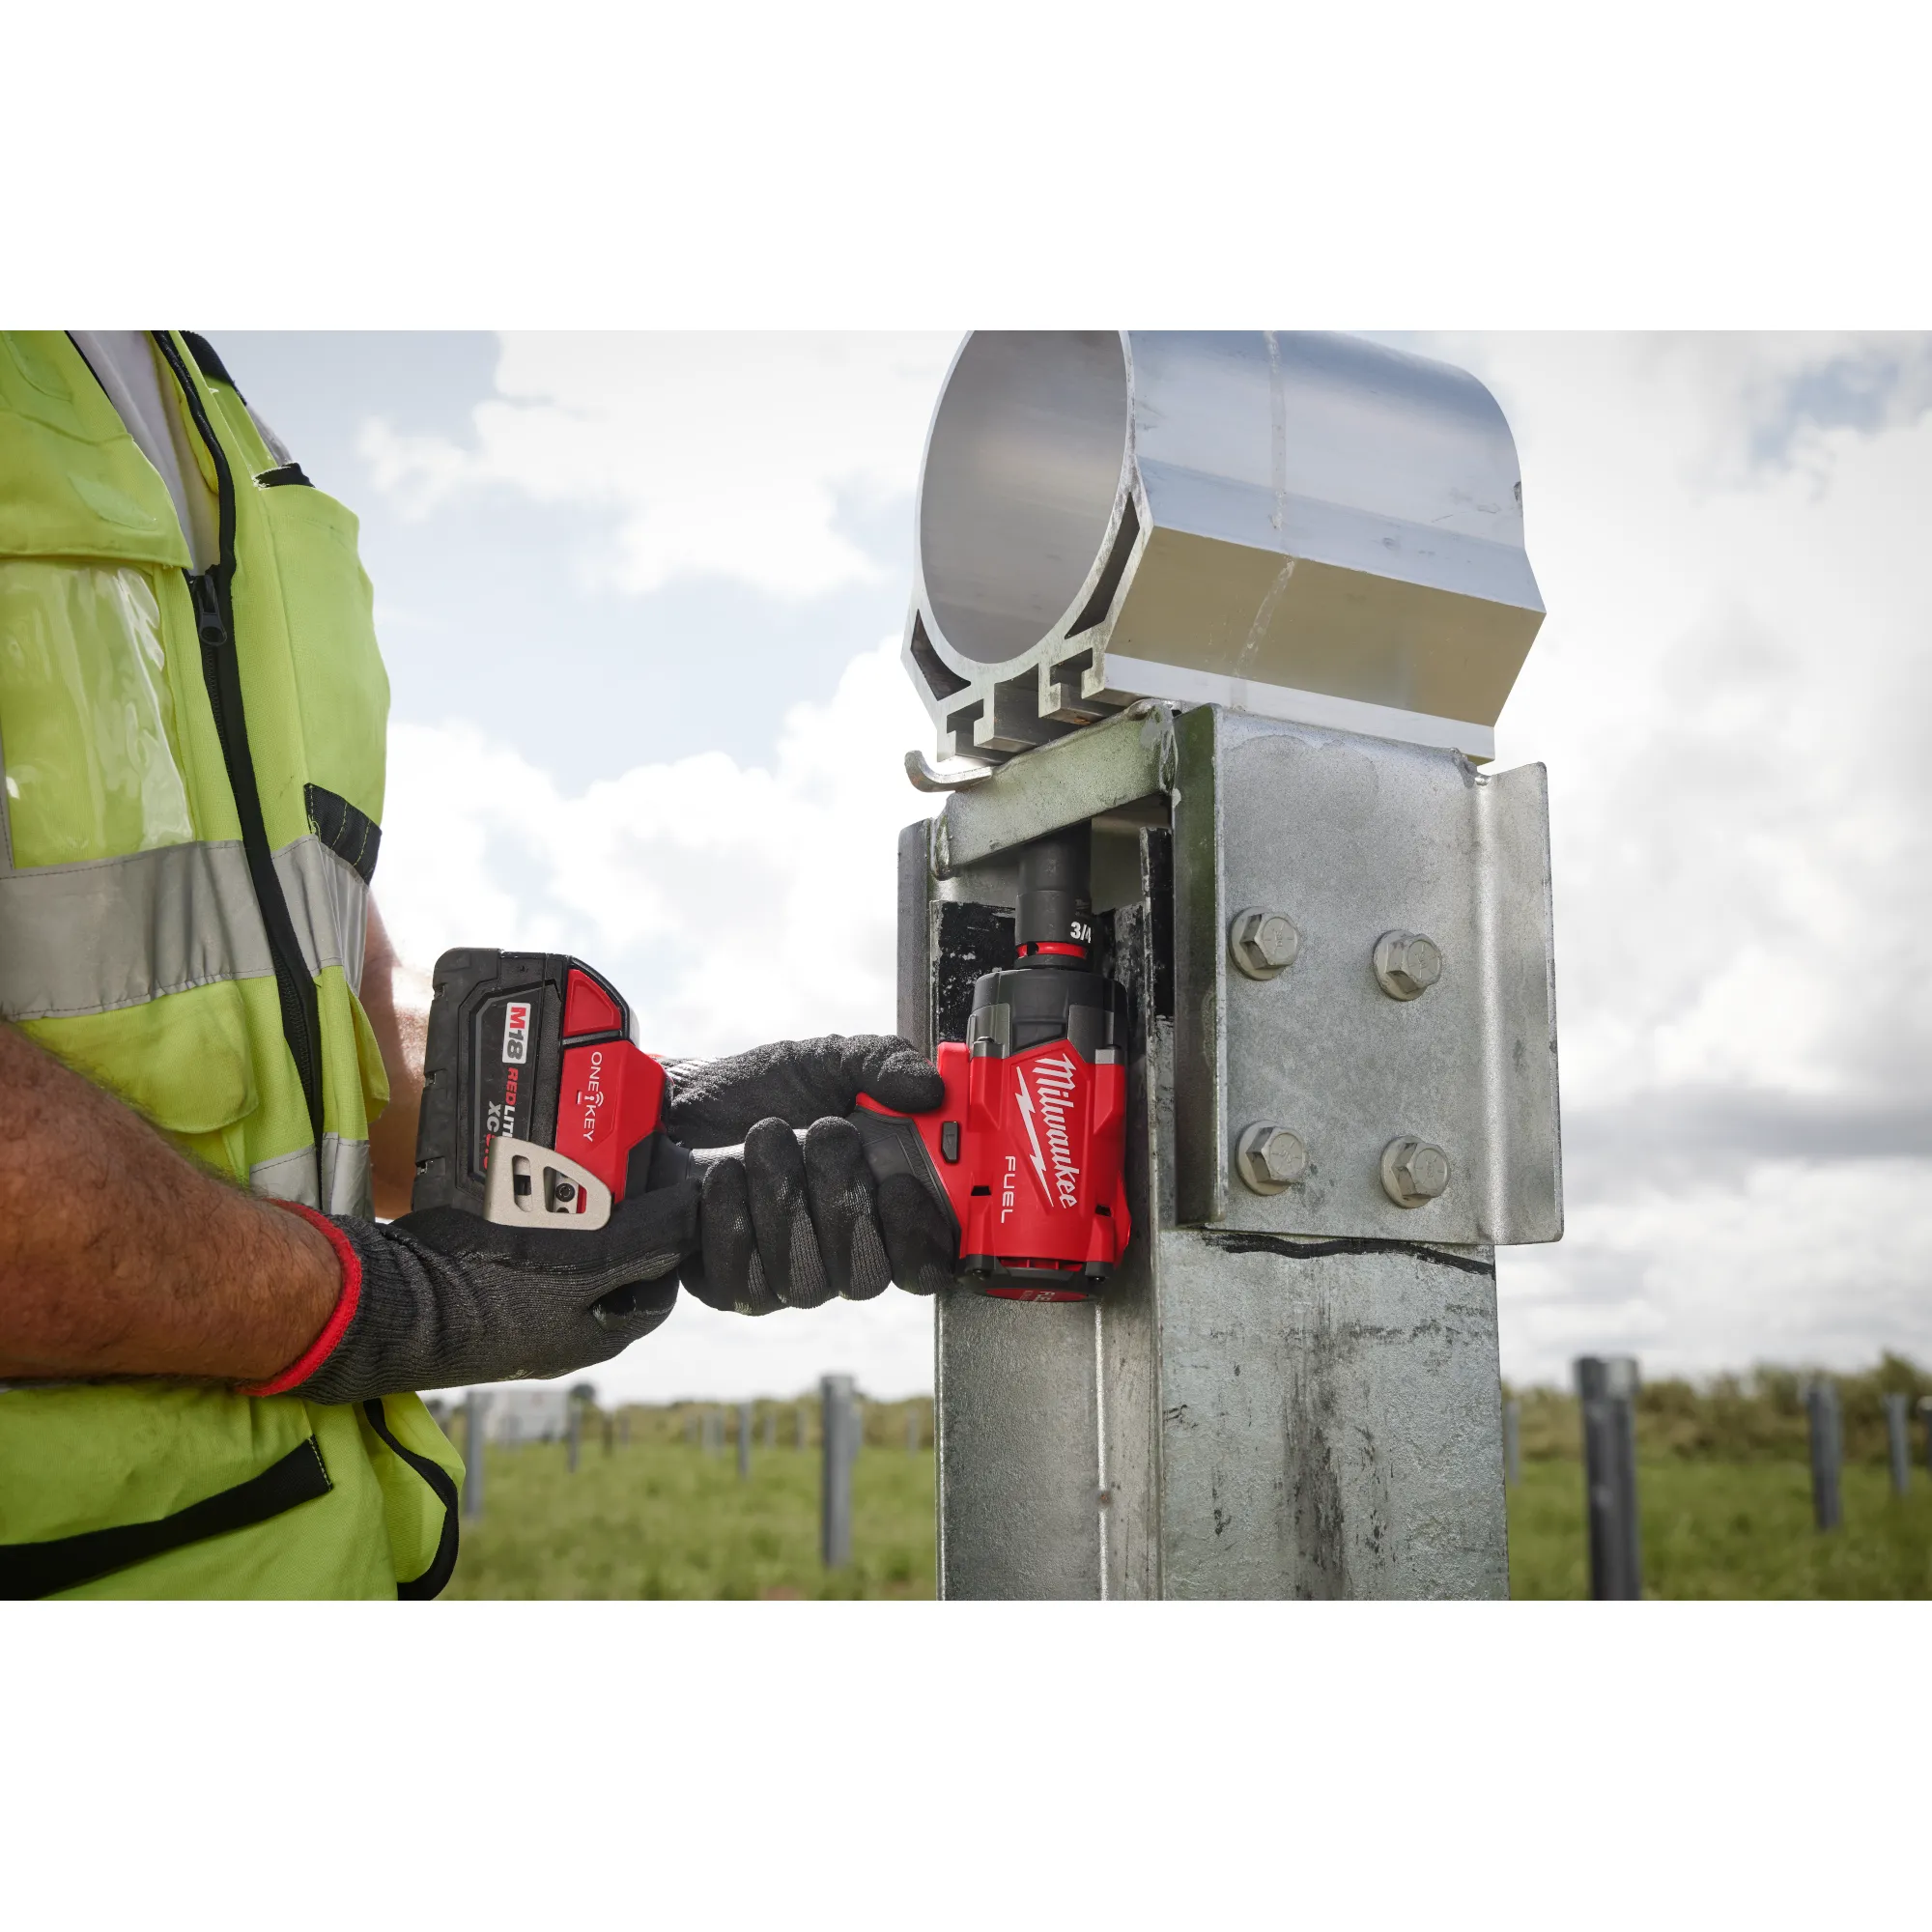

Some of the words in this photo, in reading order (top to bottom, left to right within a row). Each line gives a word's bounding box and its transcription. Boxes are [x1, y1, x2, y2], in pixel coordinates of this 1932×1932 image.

[1069, 921, 1092, 944] 3/4
[507, 1007, 526, 1061] M18
[587, 1051, 603, 1093] ONE
[486, 1100, 501, 1134] XC
[582, 1104, 597, 1142] KEY
[1032, 1053, 1080, 1209] Milwaukee
[1001, 1155, 1017, 1224] FUEL
